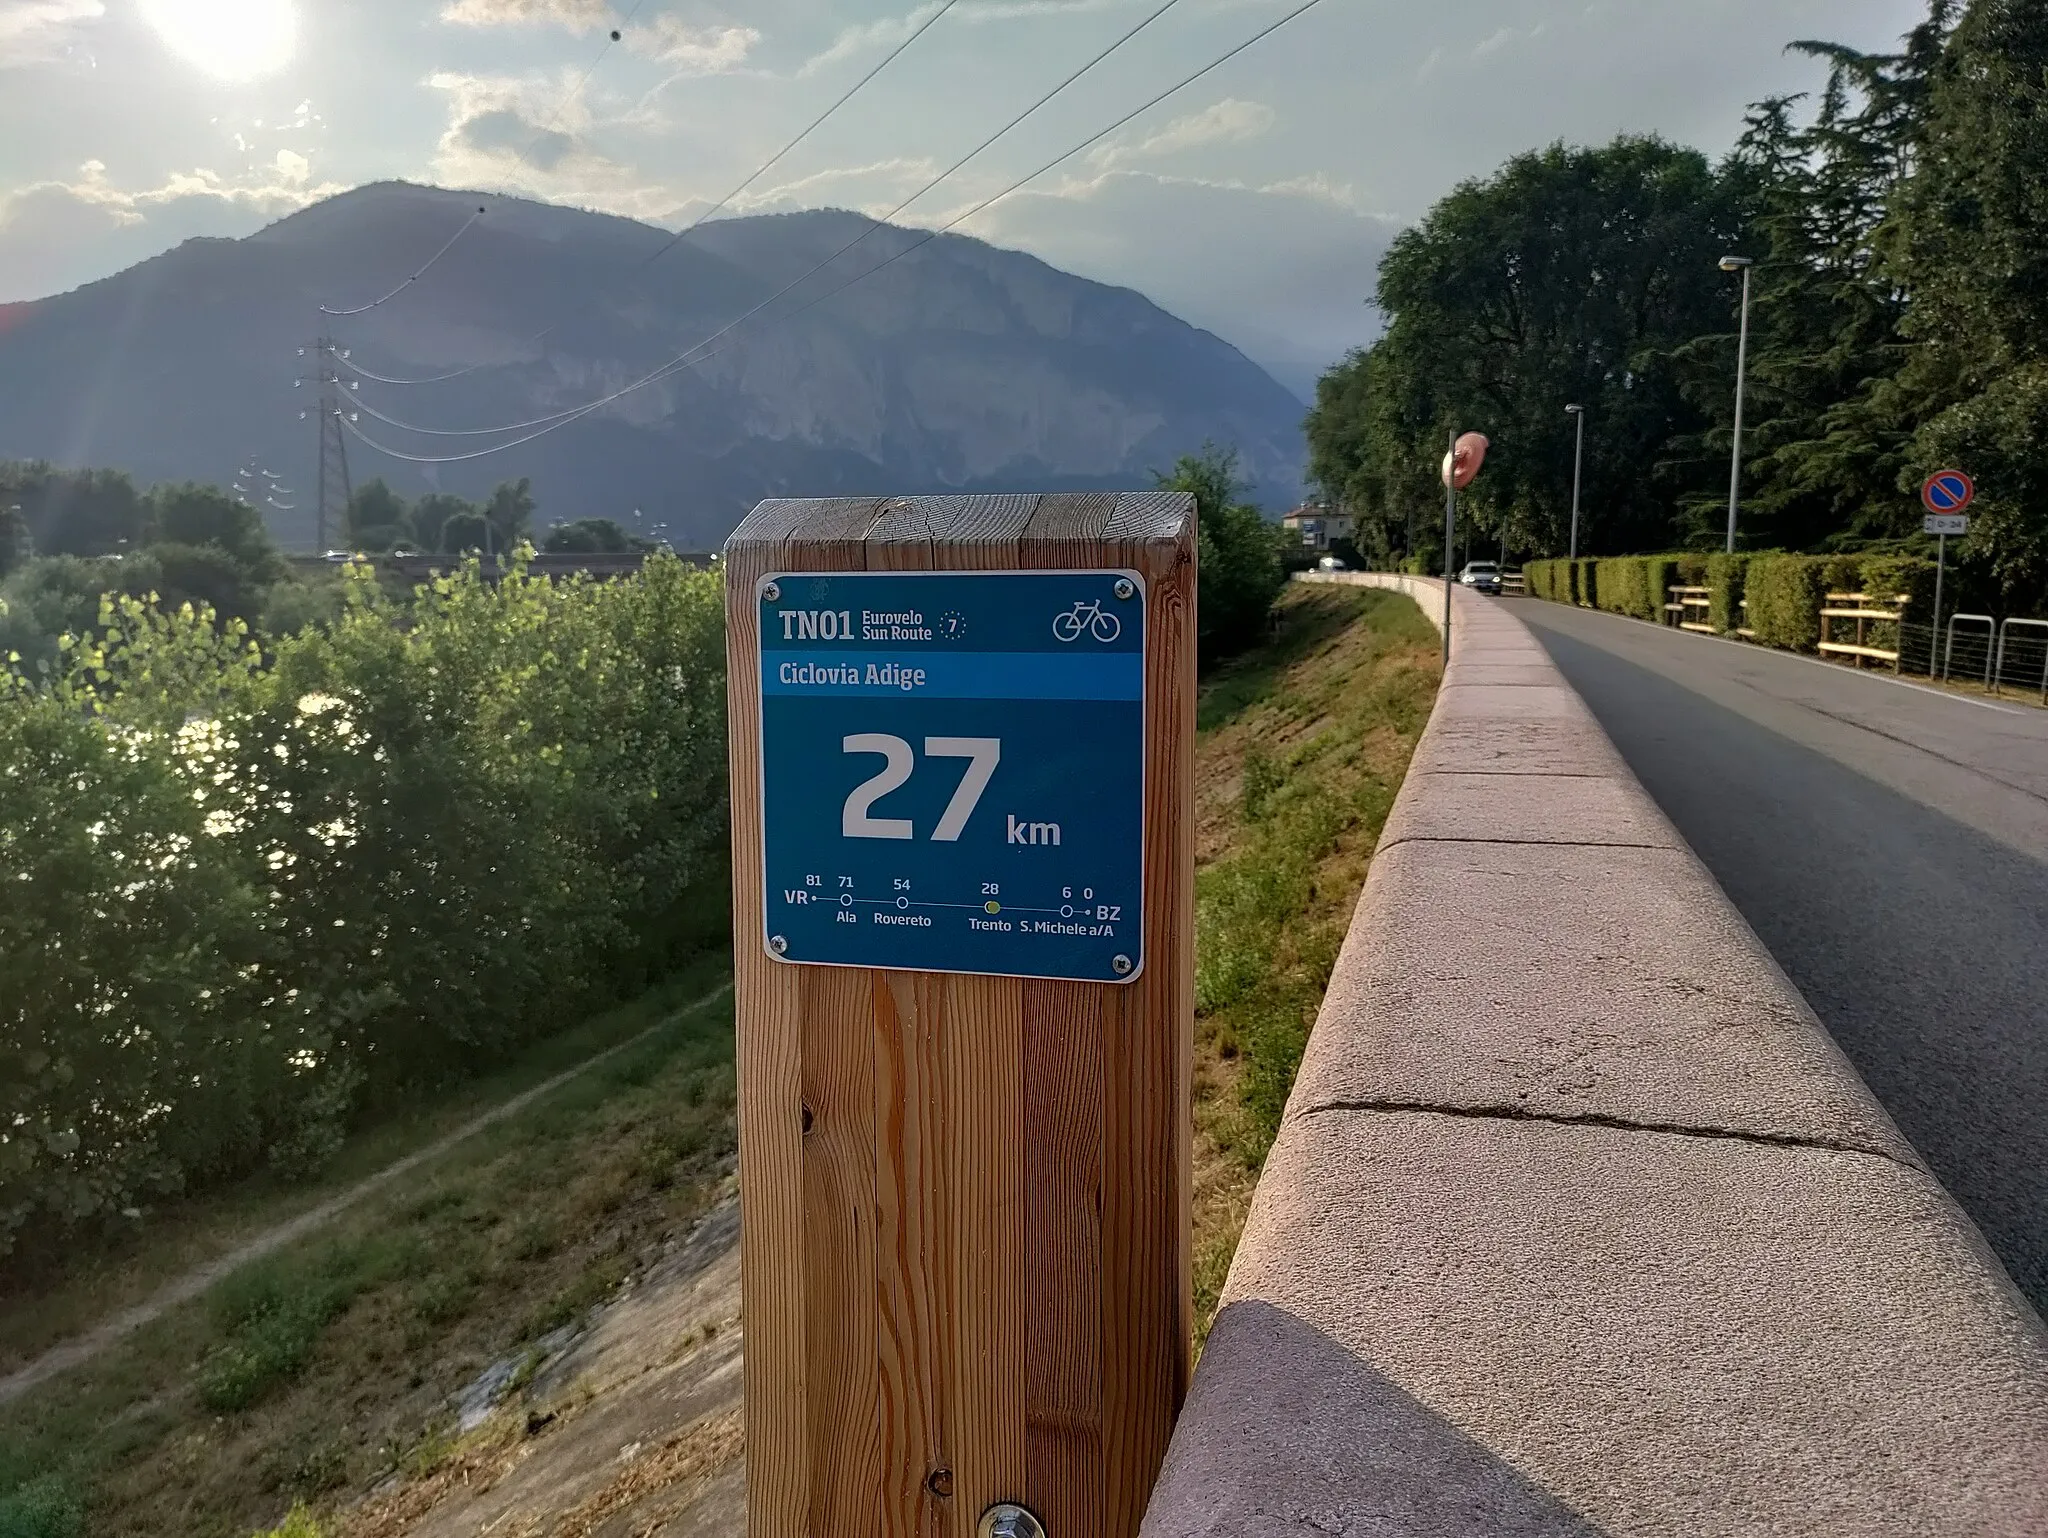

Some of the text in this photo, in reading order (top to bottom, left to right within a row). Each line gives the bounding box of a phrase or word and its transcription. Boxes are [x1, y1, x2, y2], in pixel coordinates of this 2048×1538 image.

[778, 610, 855, 640] TN01
[862, 610, 923, 626] Eurovelo
[948, 618, 957, 633] 7
[862, 625, 932, 641] Sun Route
[779, 662, 926, 691] Ciclovia Adige
[842, 733, 1001, 842] 27
[1007, 815, 1061, 846] km
[806, 875, 822, 887] 81
[838, 875, 854, 888] 71
[893, 878, 911, 891] 54
[981, 882, 999, 896] 28
[1062, 886, 1072, 899] 6
[1083, 887, 1093, 900] 0
[784, 889, 808, 905] VR
[836, 911, 857, 923] Ala
[874, 912, 932, 927] Rovereto
[1096, 905, 1121, 921] BZ
[968, 917, 1012, 932] Trento
